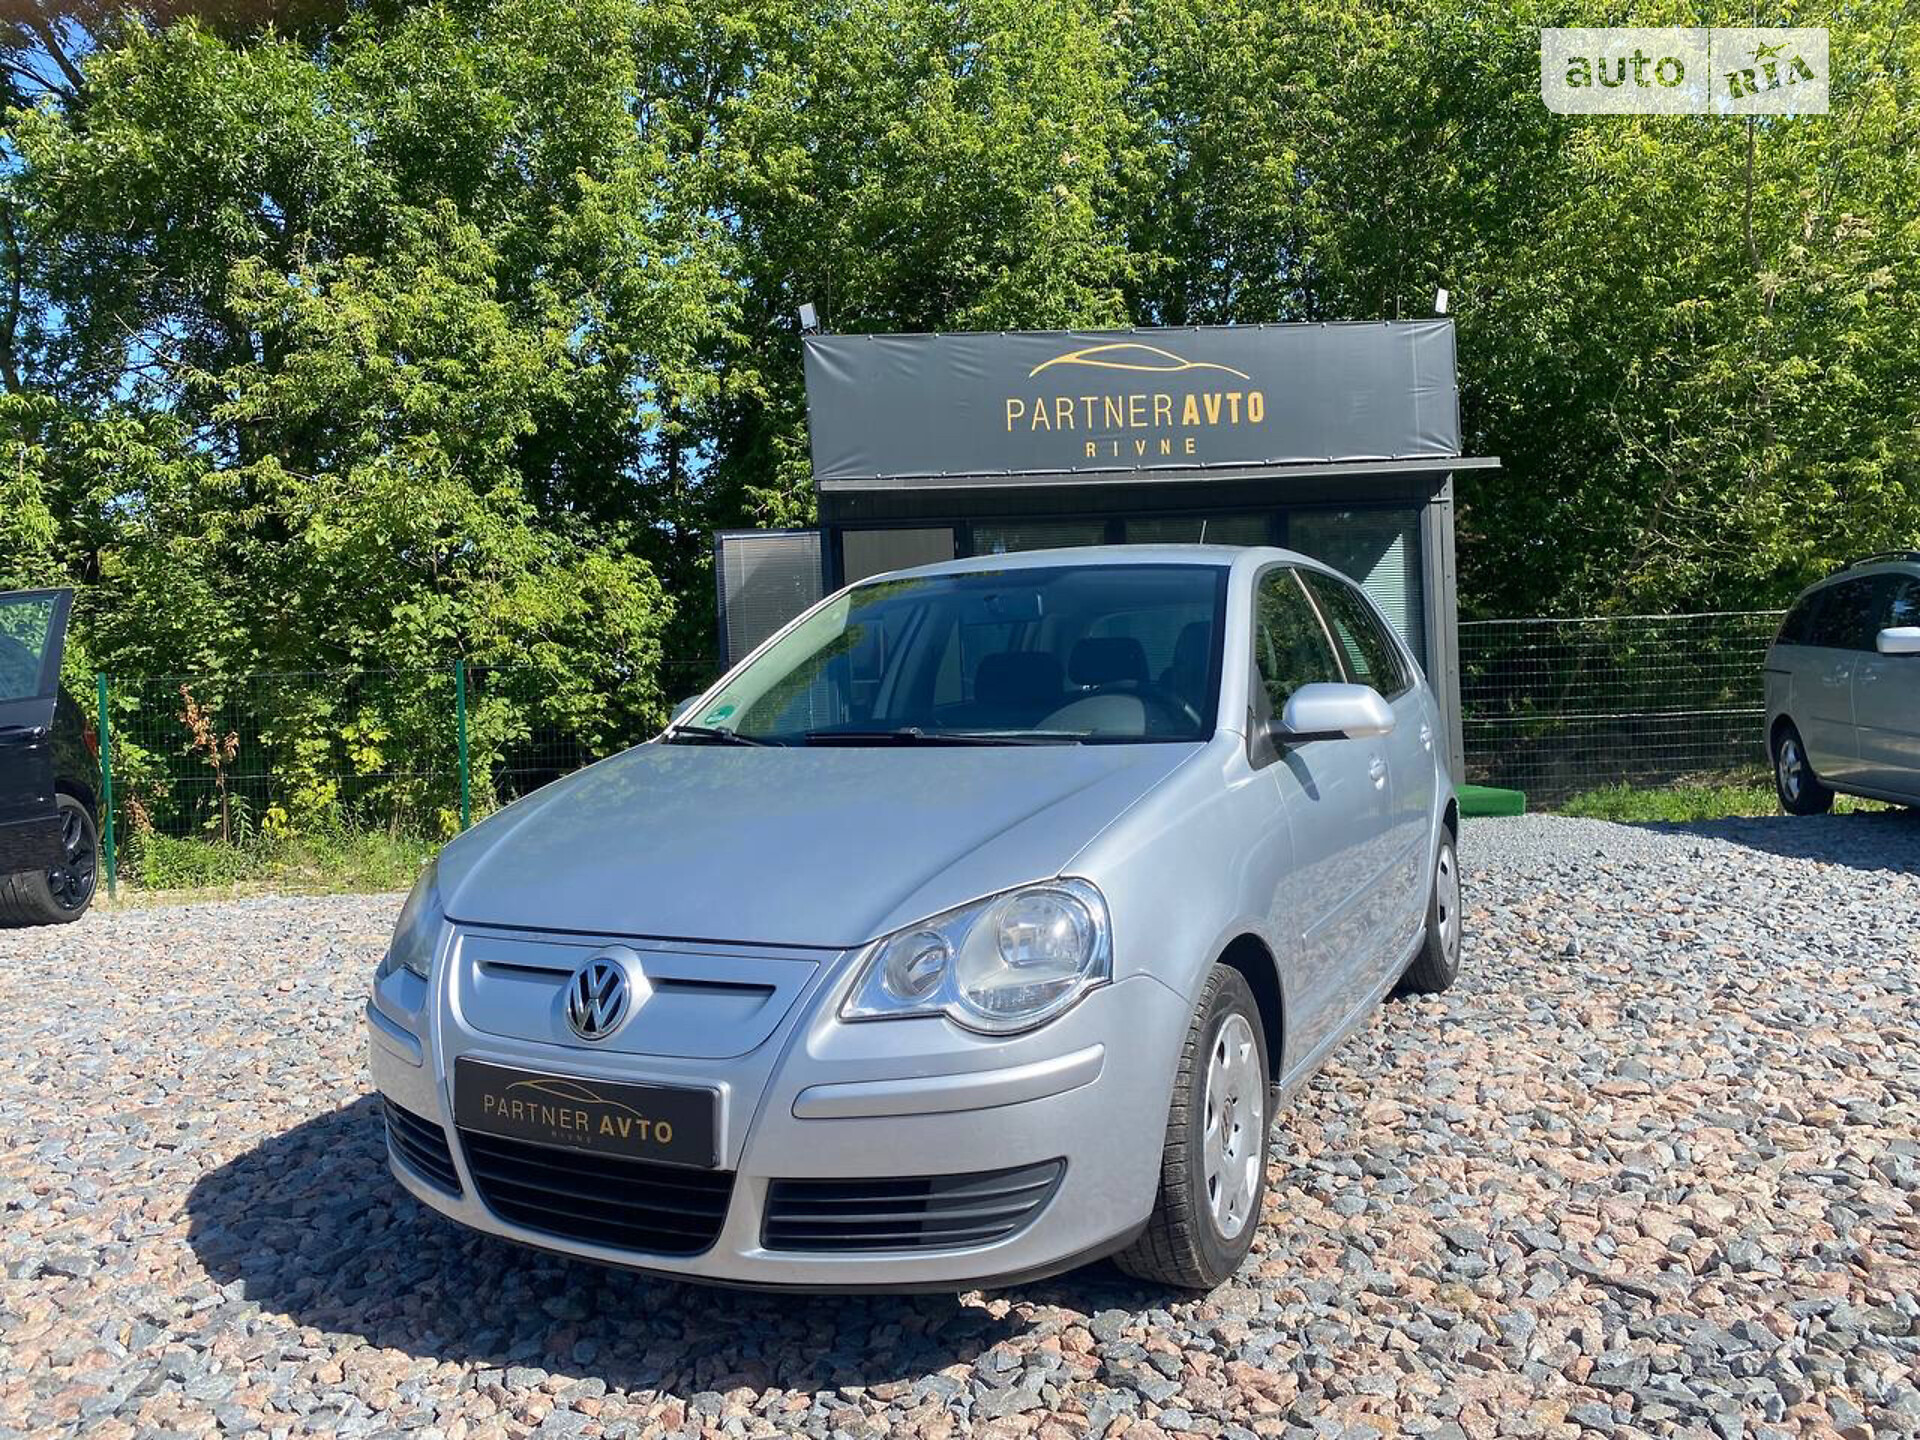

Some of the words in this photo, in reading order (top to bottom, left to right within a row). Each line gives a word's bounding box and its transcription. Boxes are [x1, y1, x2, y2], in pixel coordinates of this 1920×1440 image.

[1086, 438, 1196, 457] RIVNE
[483, 1094, 589, 1132] PARTNER
[599, 1115, 673, 1143] AVTO
